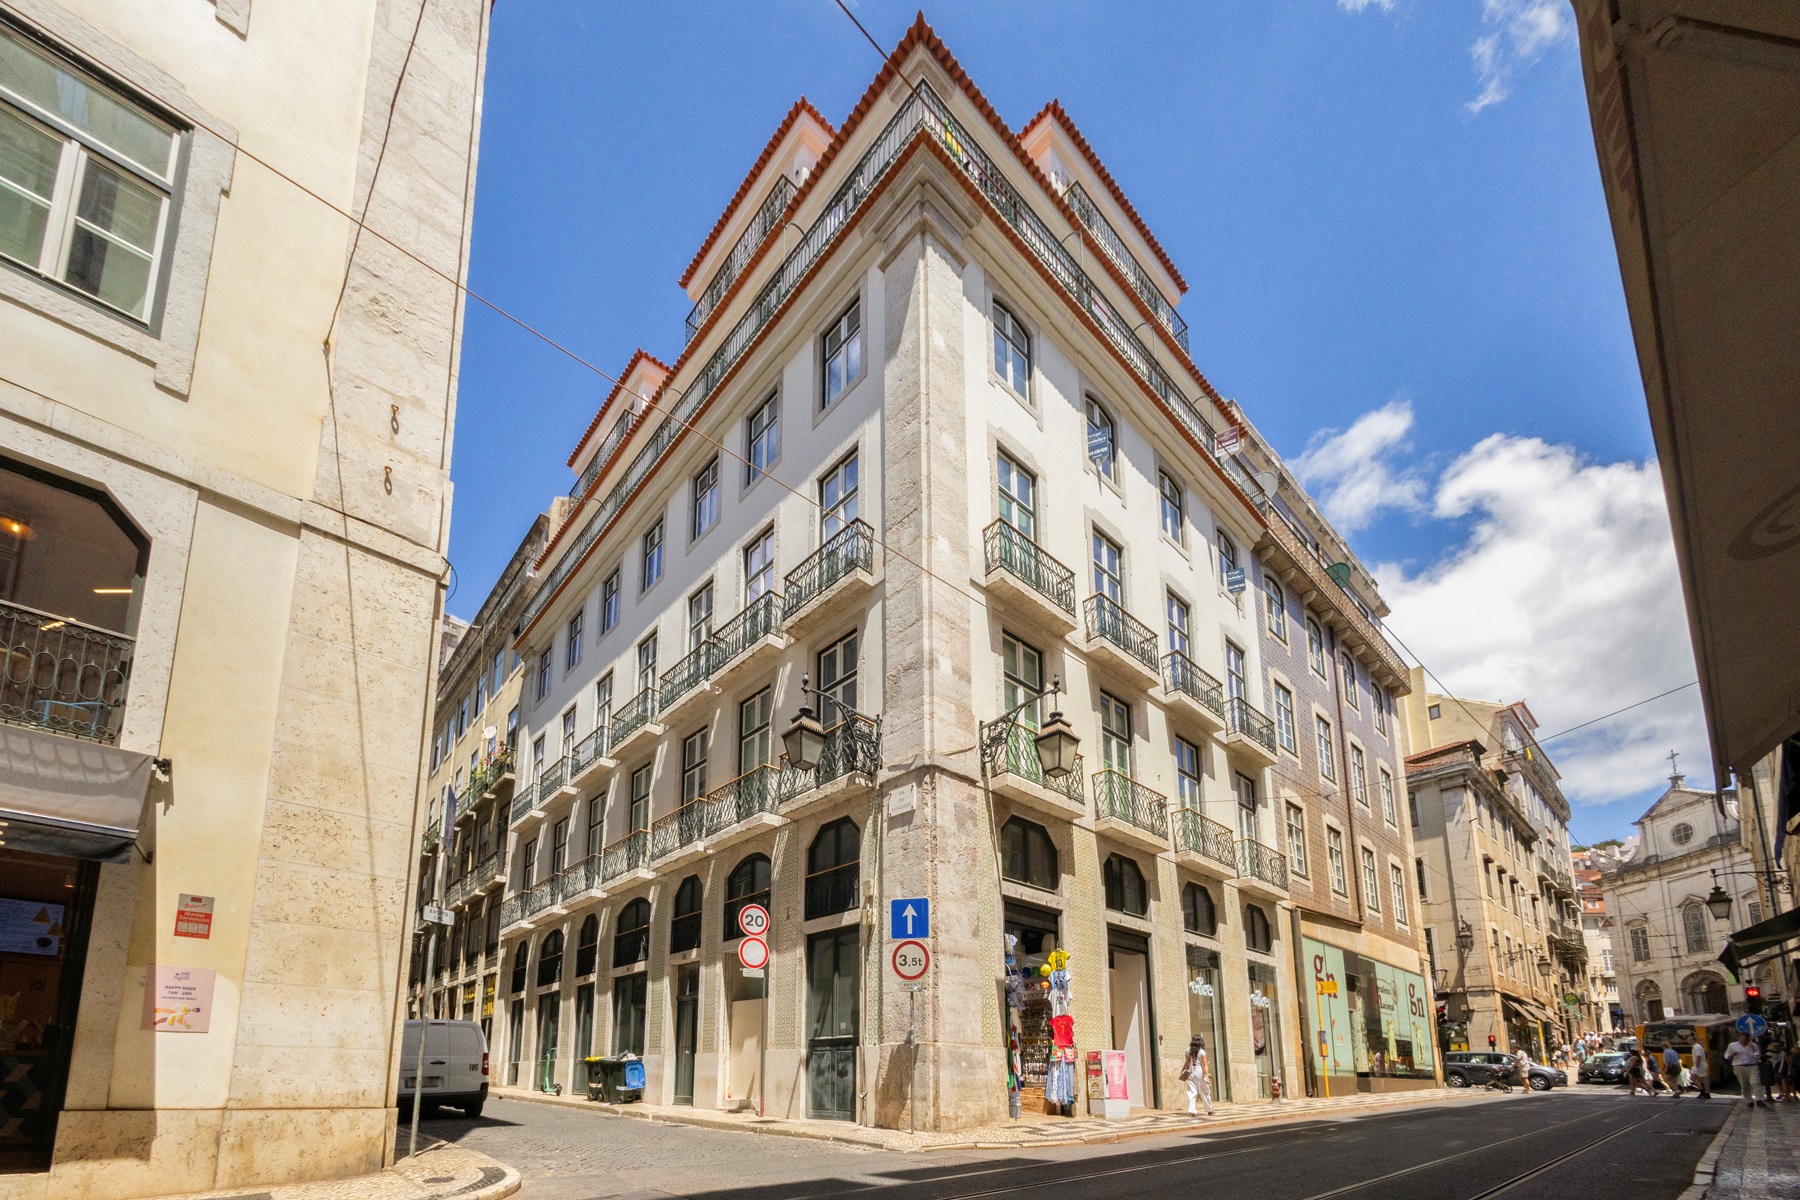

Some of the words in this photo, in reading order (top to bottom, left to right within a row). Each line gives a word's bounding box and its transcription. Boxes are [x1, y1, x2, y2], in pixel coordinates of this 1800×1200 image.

[745, 914, 764, 927] 20
[1408, 983, 1426, 1018] gn
[469, 1064, 479, 1072] FIAT
